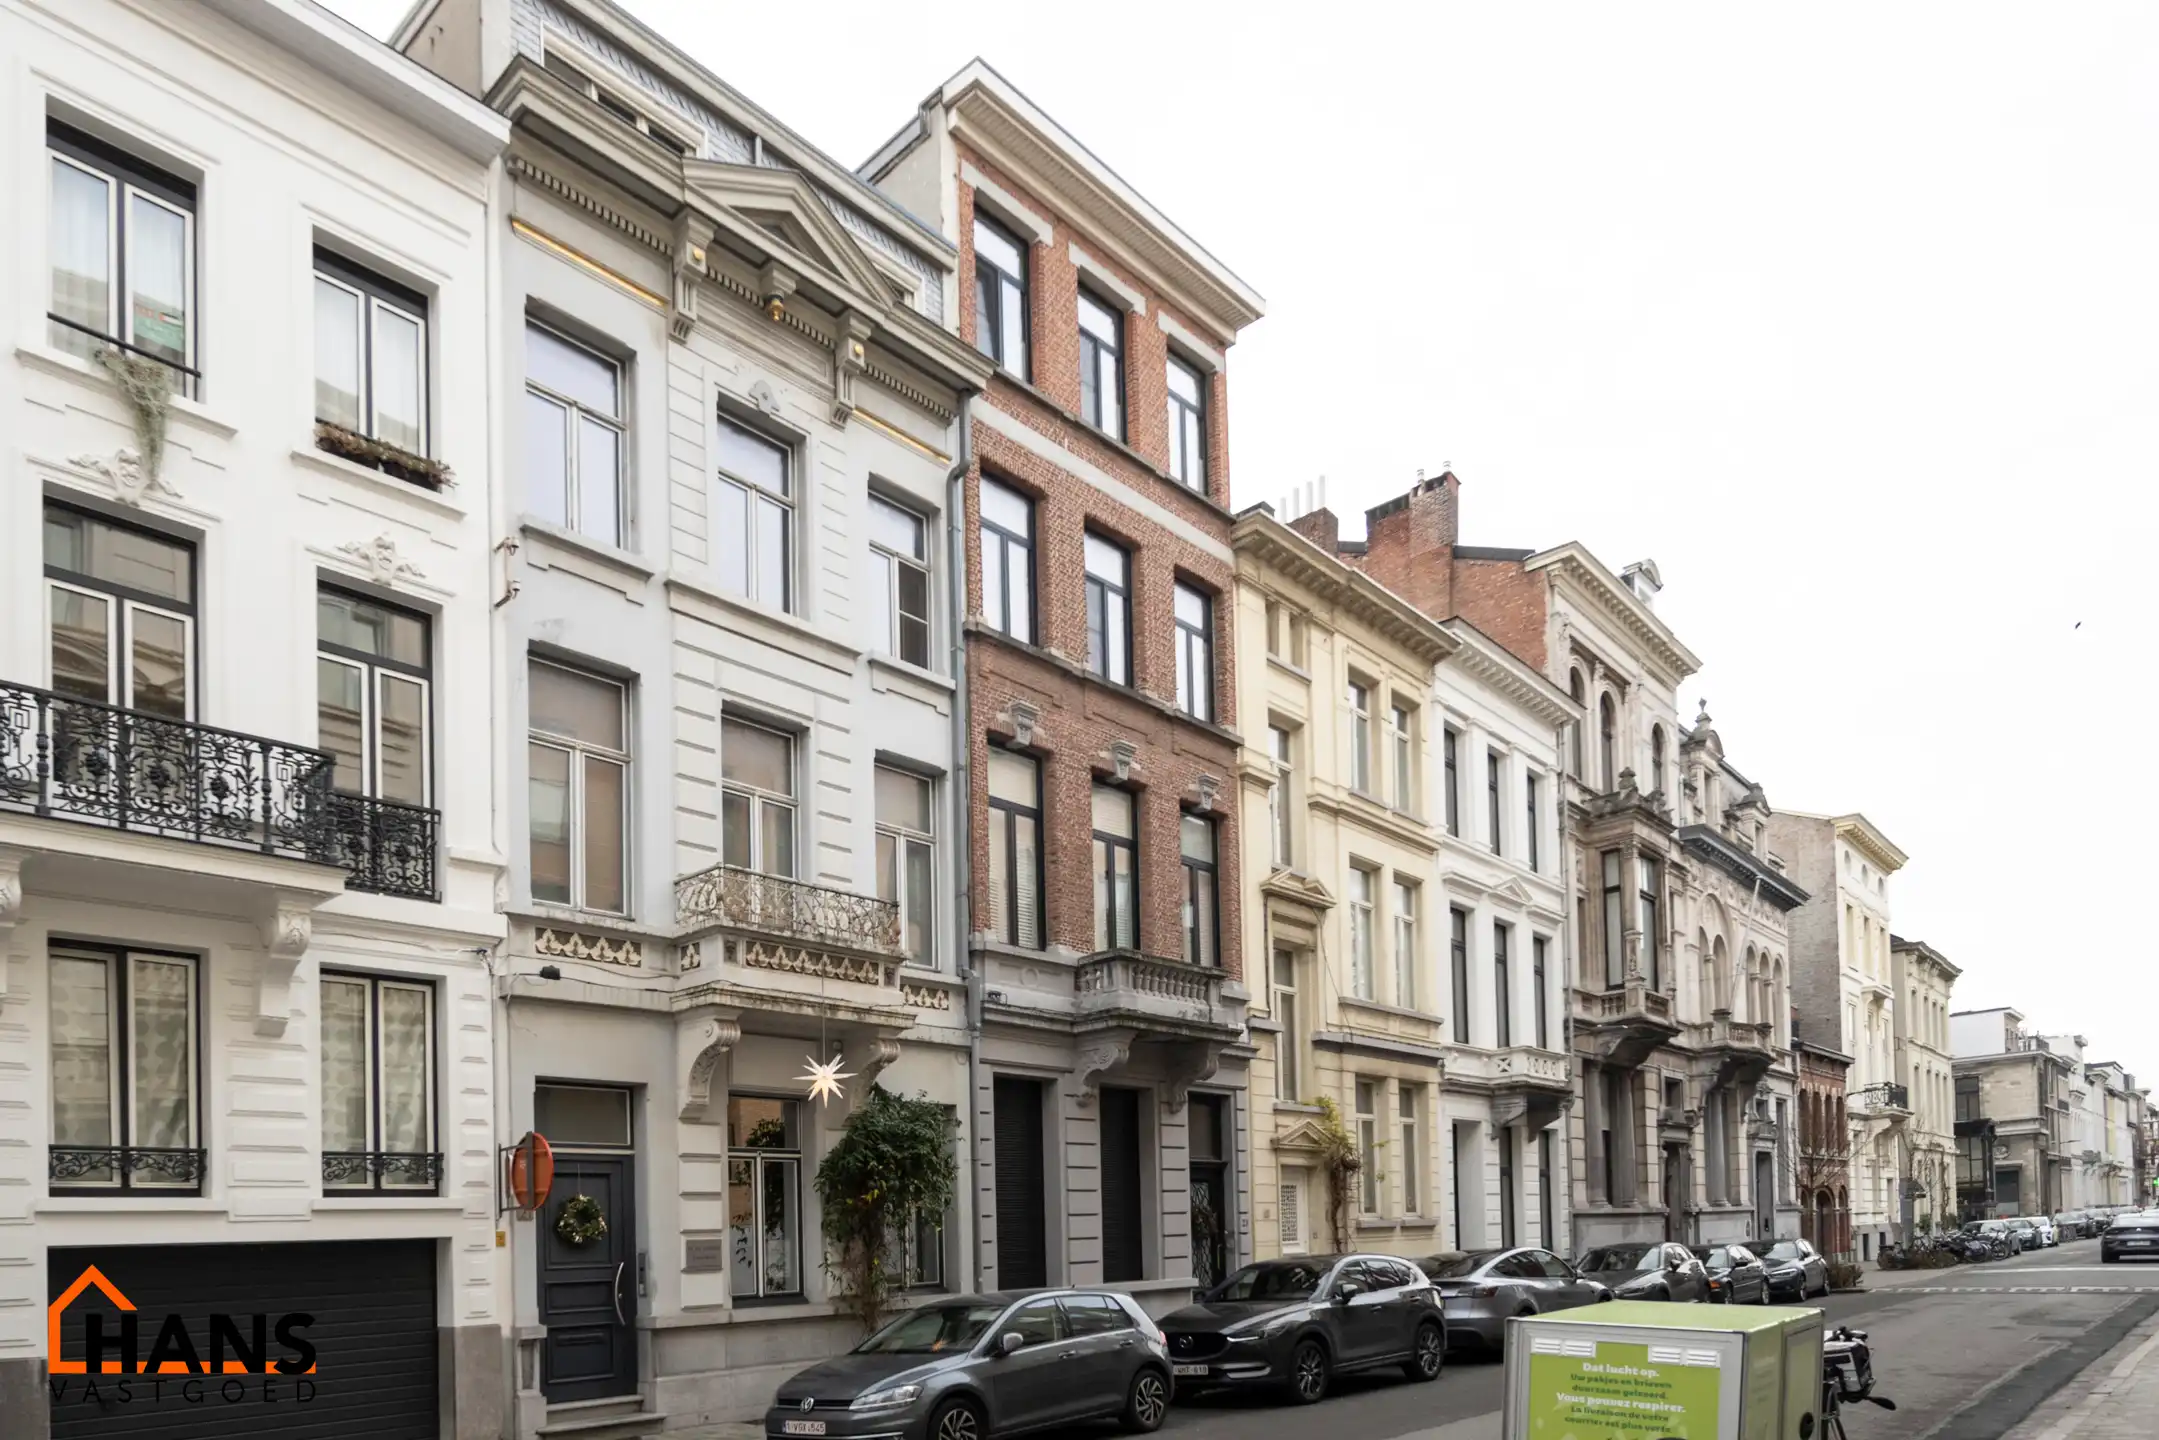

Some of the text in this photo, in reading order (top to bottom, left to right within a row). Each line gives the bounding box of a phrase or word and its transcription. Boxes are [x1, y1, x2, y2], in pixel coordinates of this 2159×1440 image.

[1583, 1362, 1660, 1379] Dat lucht op.
[1556, 1392, 1686, 1413] Vous pouvez respirer.
